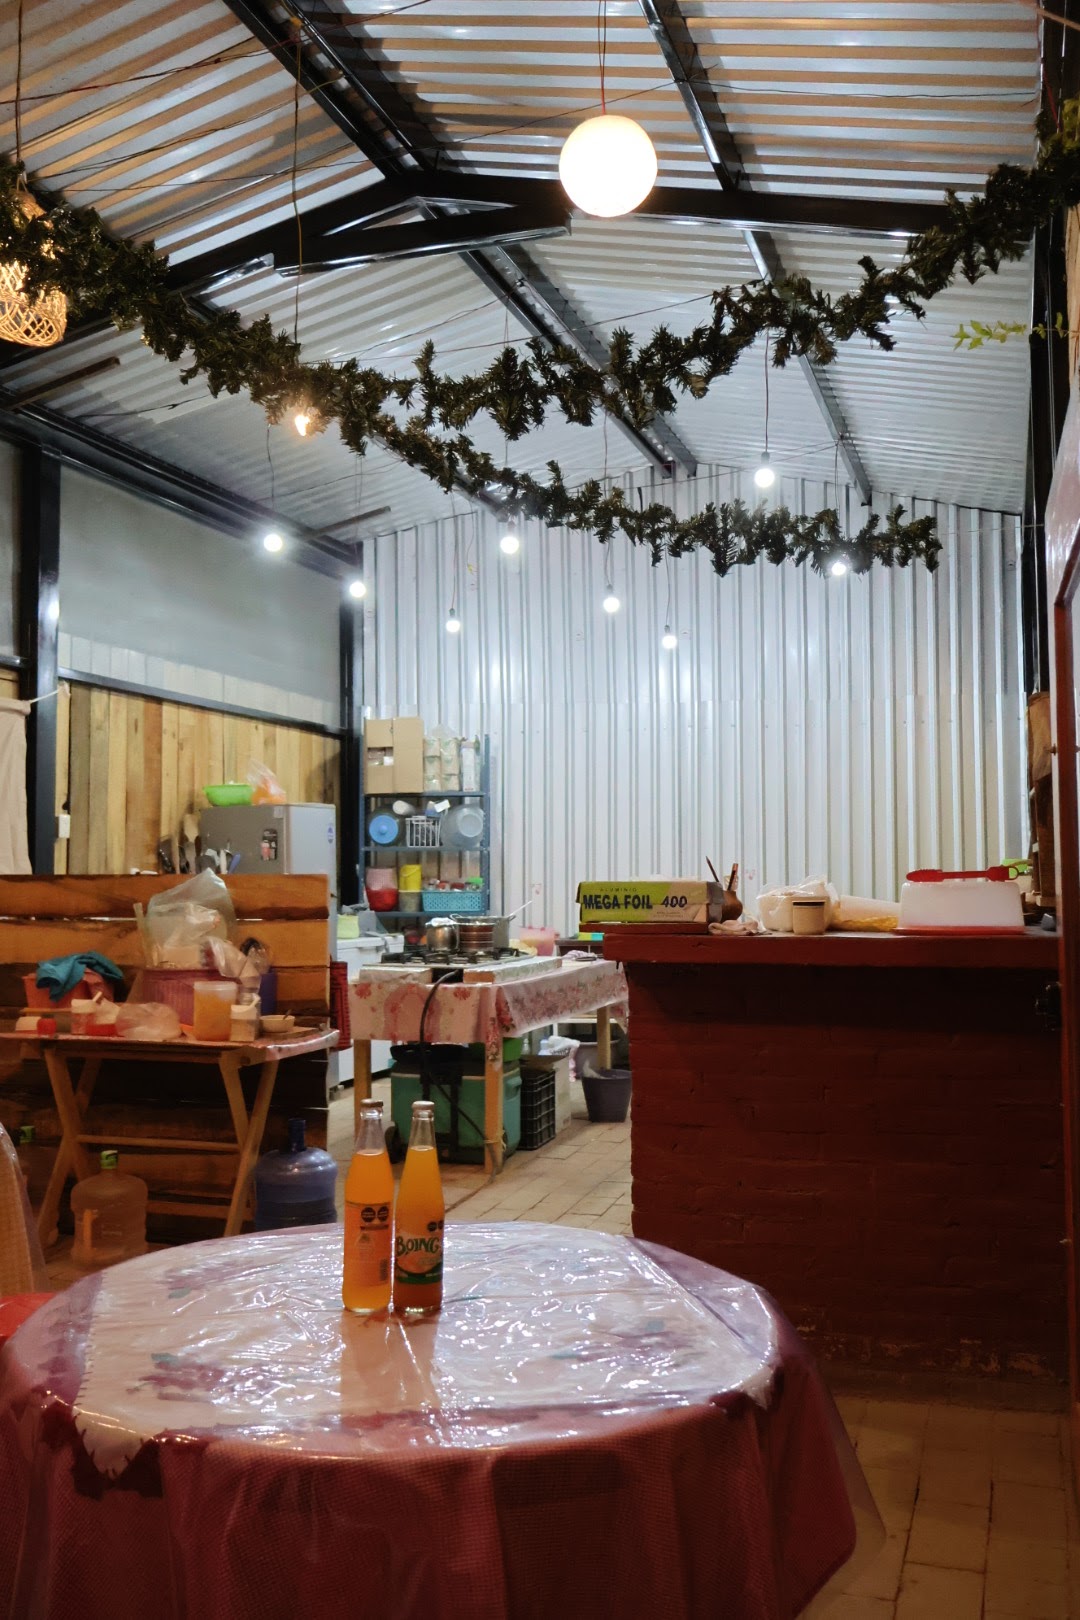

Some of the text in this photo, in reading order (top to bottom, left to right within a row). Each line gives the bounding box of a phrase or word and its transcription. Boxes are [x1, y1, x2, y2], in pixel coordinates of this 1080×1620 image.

[583, 894, 688, 910] MEGA FOIL 400
